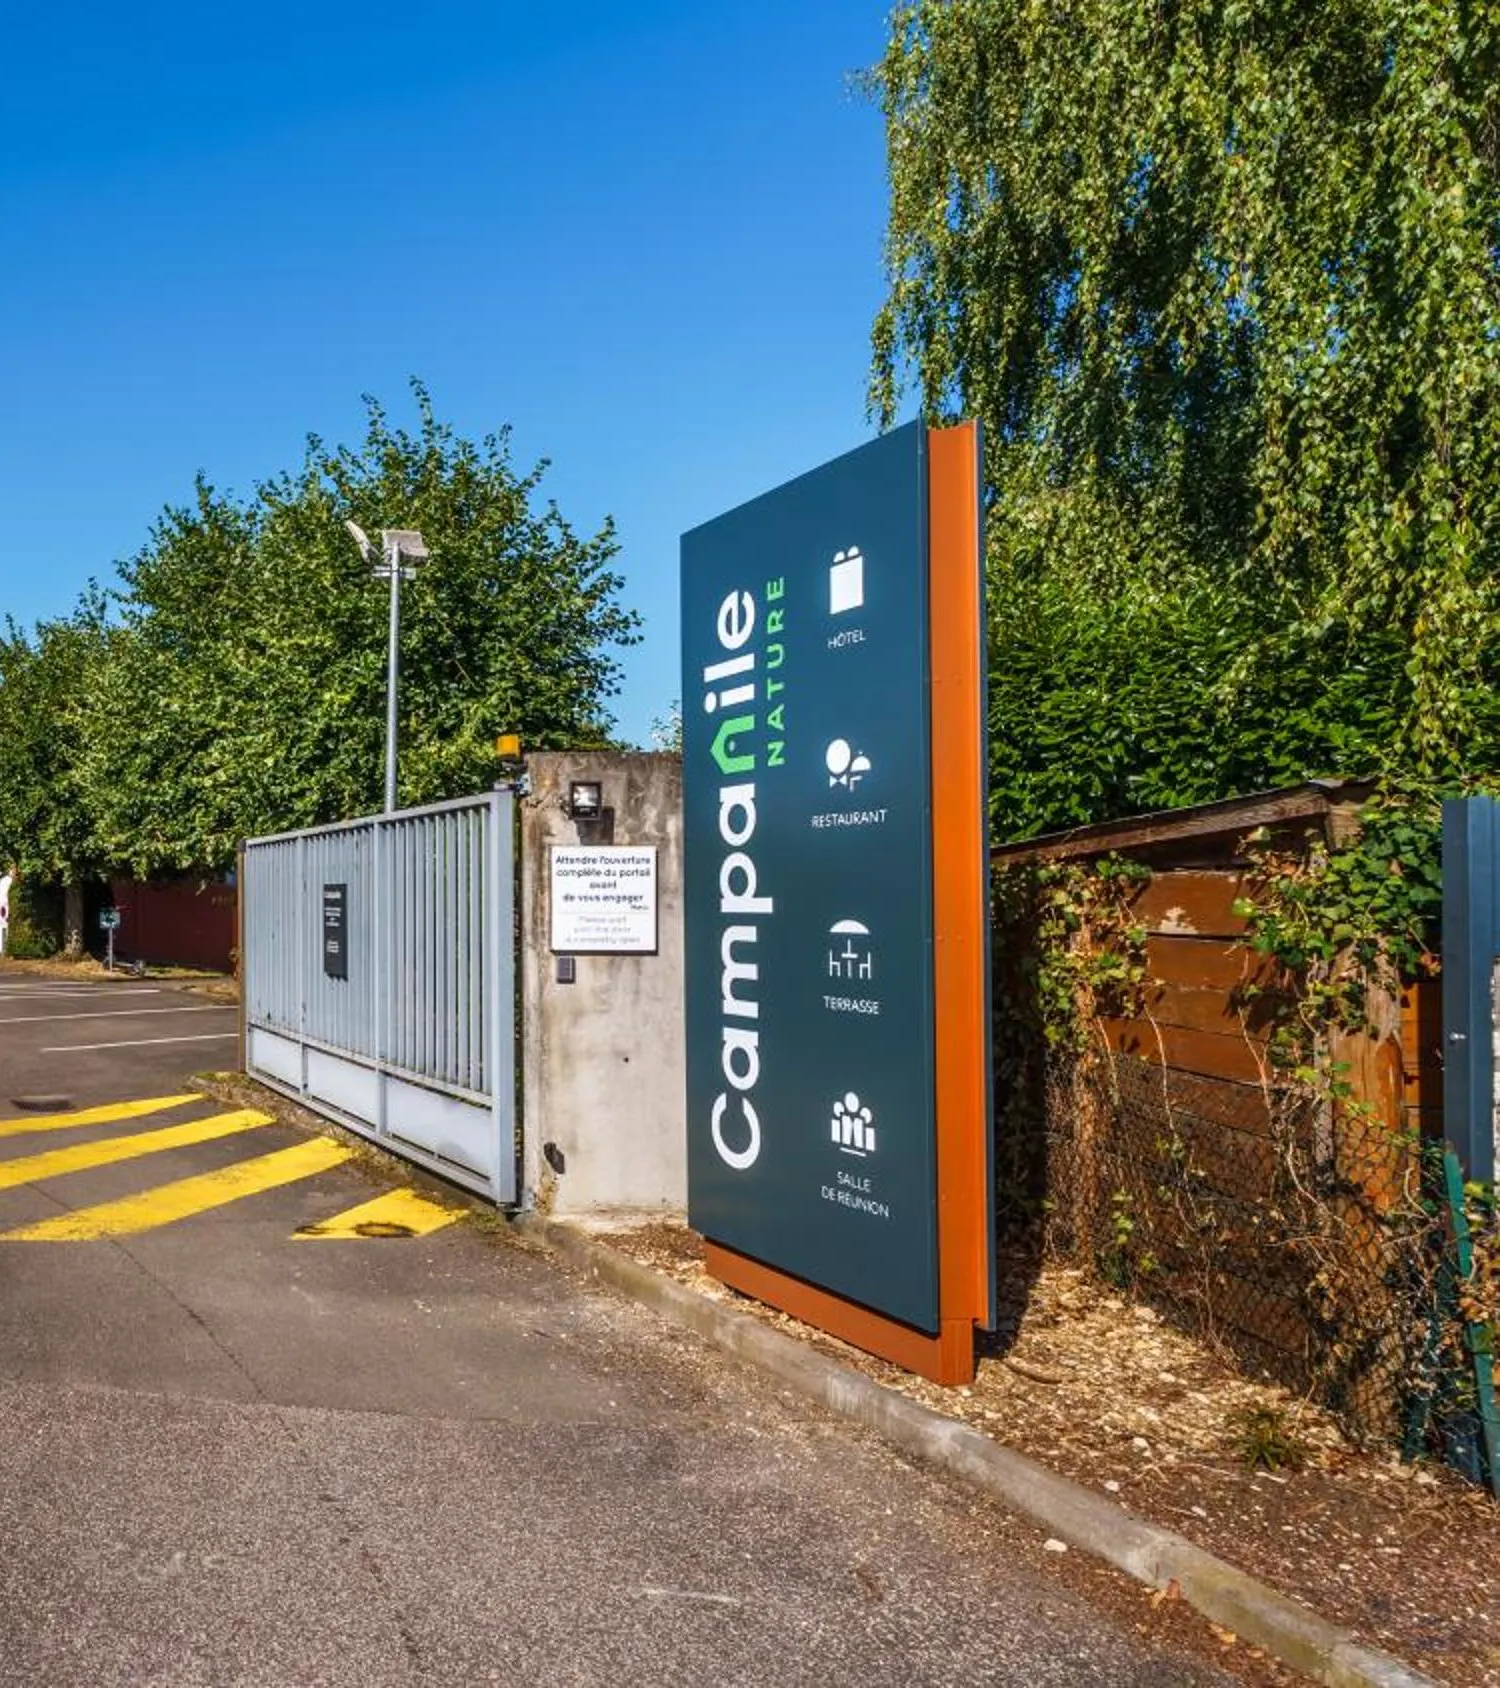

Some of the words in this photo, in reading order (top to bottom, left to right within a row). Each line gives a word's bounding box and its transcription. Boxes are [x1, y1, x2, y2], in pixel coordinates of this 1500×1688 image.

[767, 577, 785, 767] NATURE
[811, 809, 887, 828] RESTAURANT
[556, 855, 597, 865] Attendre
[704, 590, 773, 1169] Campanile
[823, 995, 880, 1015] TERRASSE
[836, 1171, 871, 1193] SALLE
[821, 1186, 835, 1201] DE
